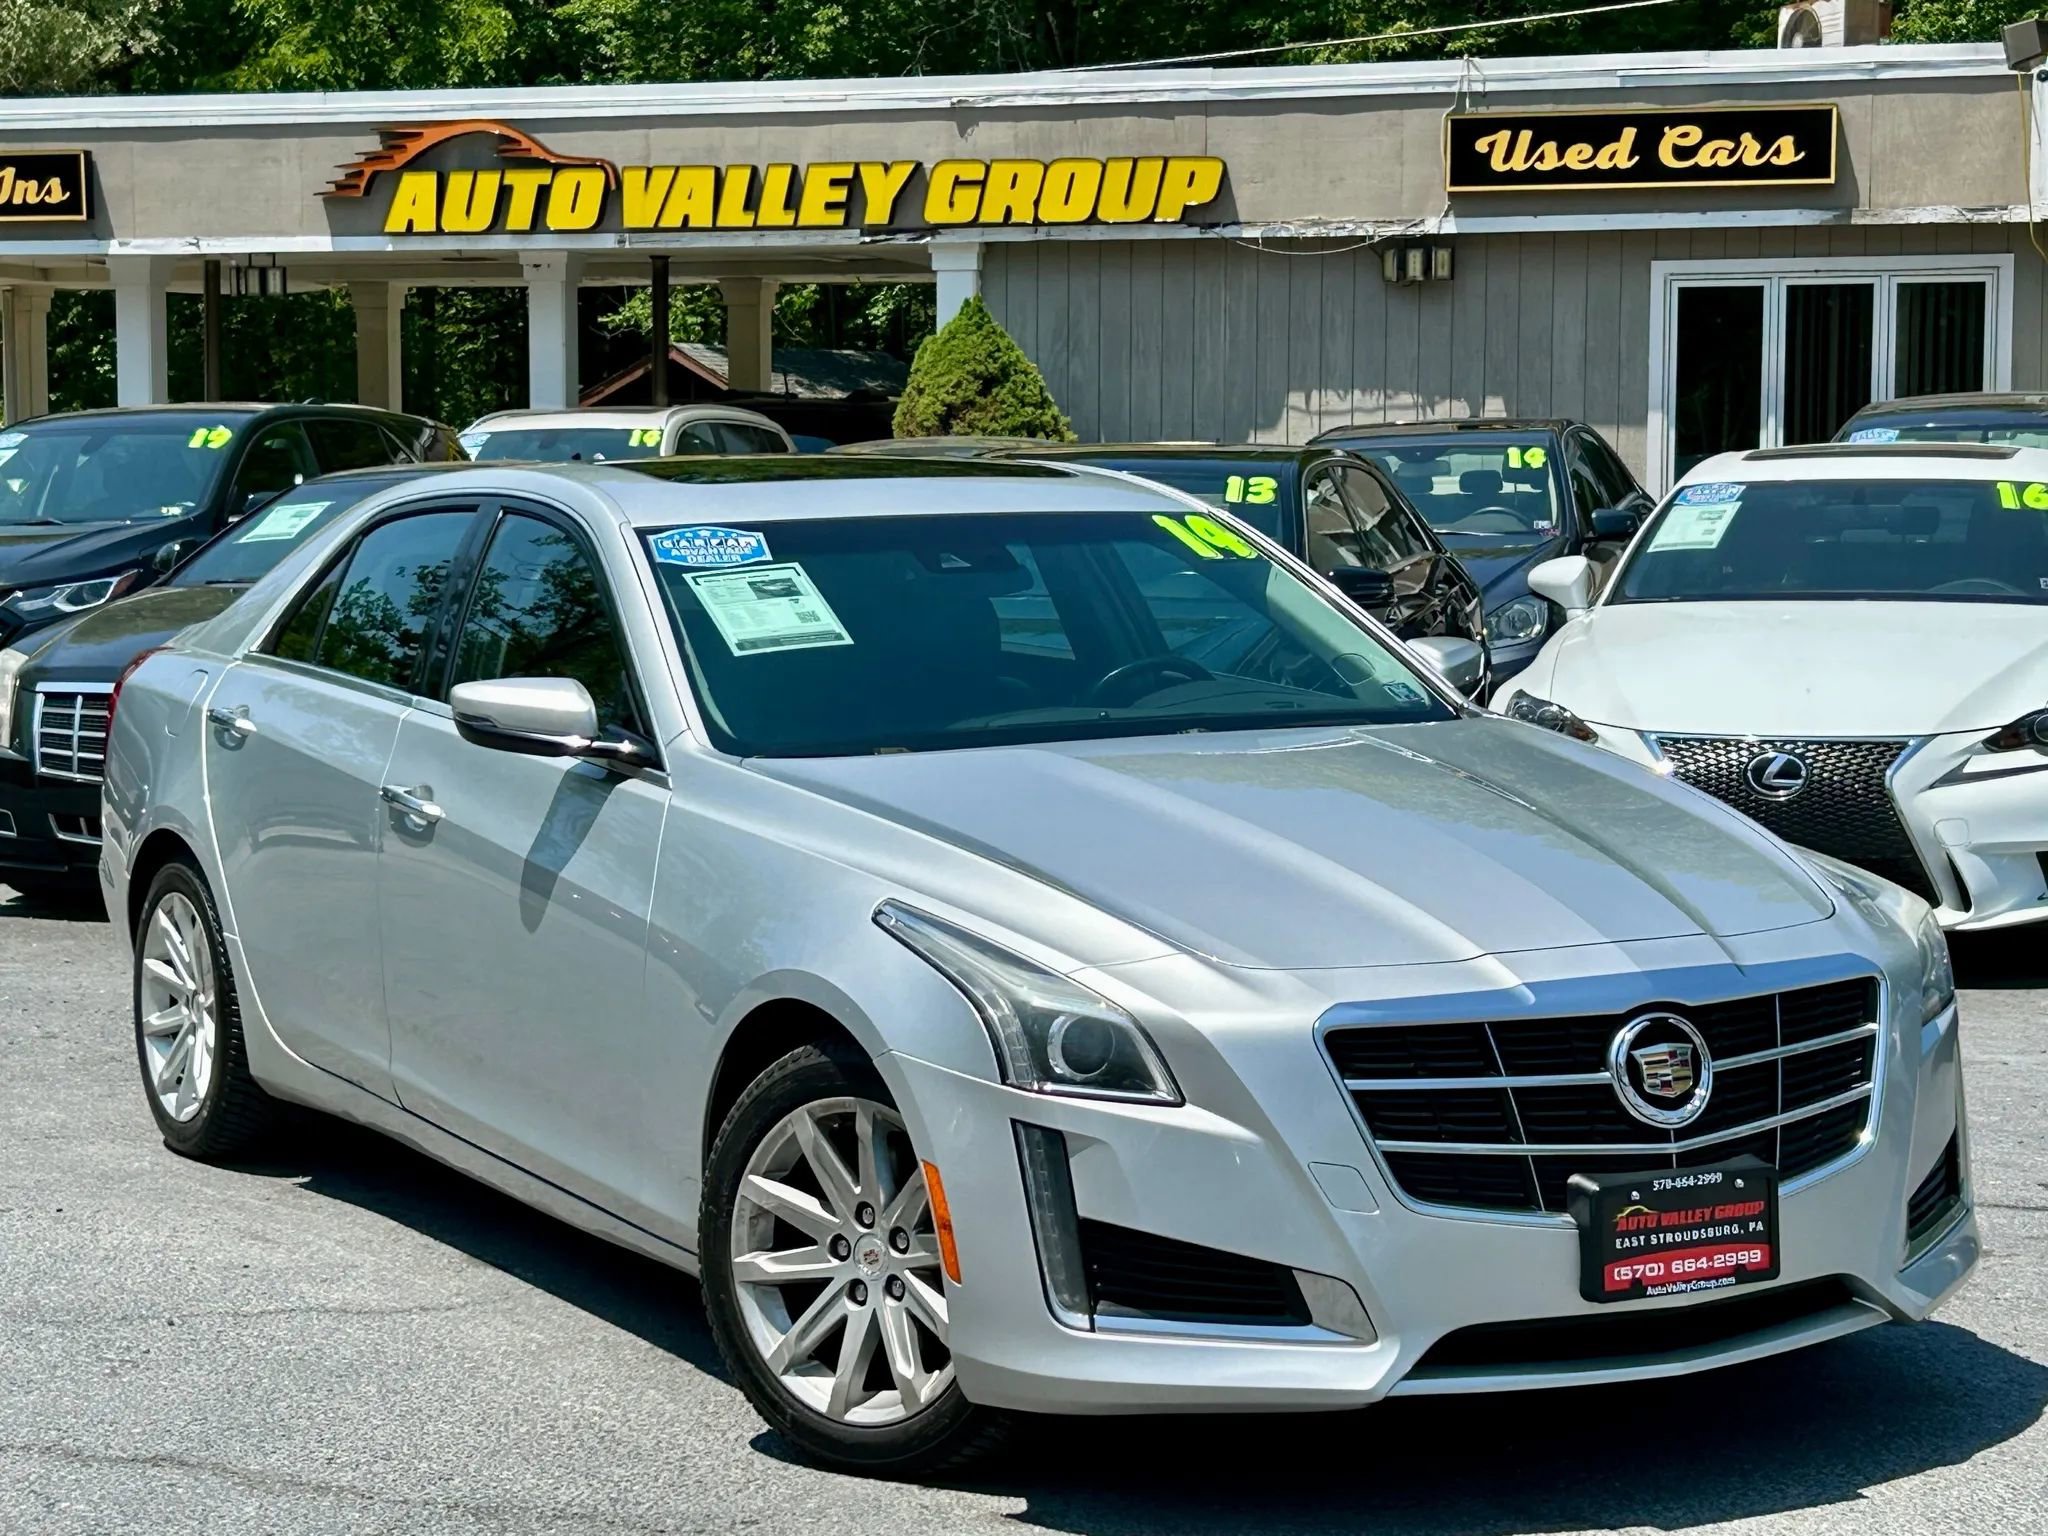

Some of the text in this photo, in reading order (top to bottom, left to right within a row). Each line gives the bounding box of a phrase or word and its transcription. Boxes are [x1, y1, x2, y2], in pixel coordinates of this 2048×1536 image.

[1474, 124, 1806, 173] Used Cars
[383, 155, 1227, 234] AUTO VALLEY GROUP
[187, 425, 233, 449] 19
[1225, 475, 1279, 505] 13
[1996, 481, 2048, 511] 16
[686, 554, 743, 564] DEALER
[1615, 1200, 1765, 1232] AUTO VALLEY GROUP
[1615, 1220, 1764, 1250] EAST STROUDSBURG, PA
[1613, 1248, 1762, 1282] (570) 664-2999
